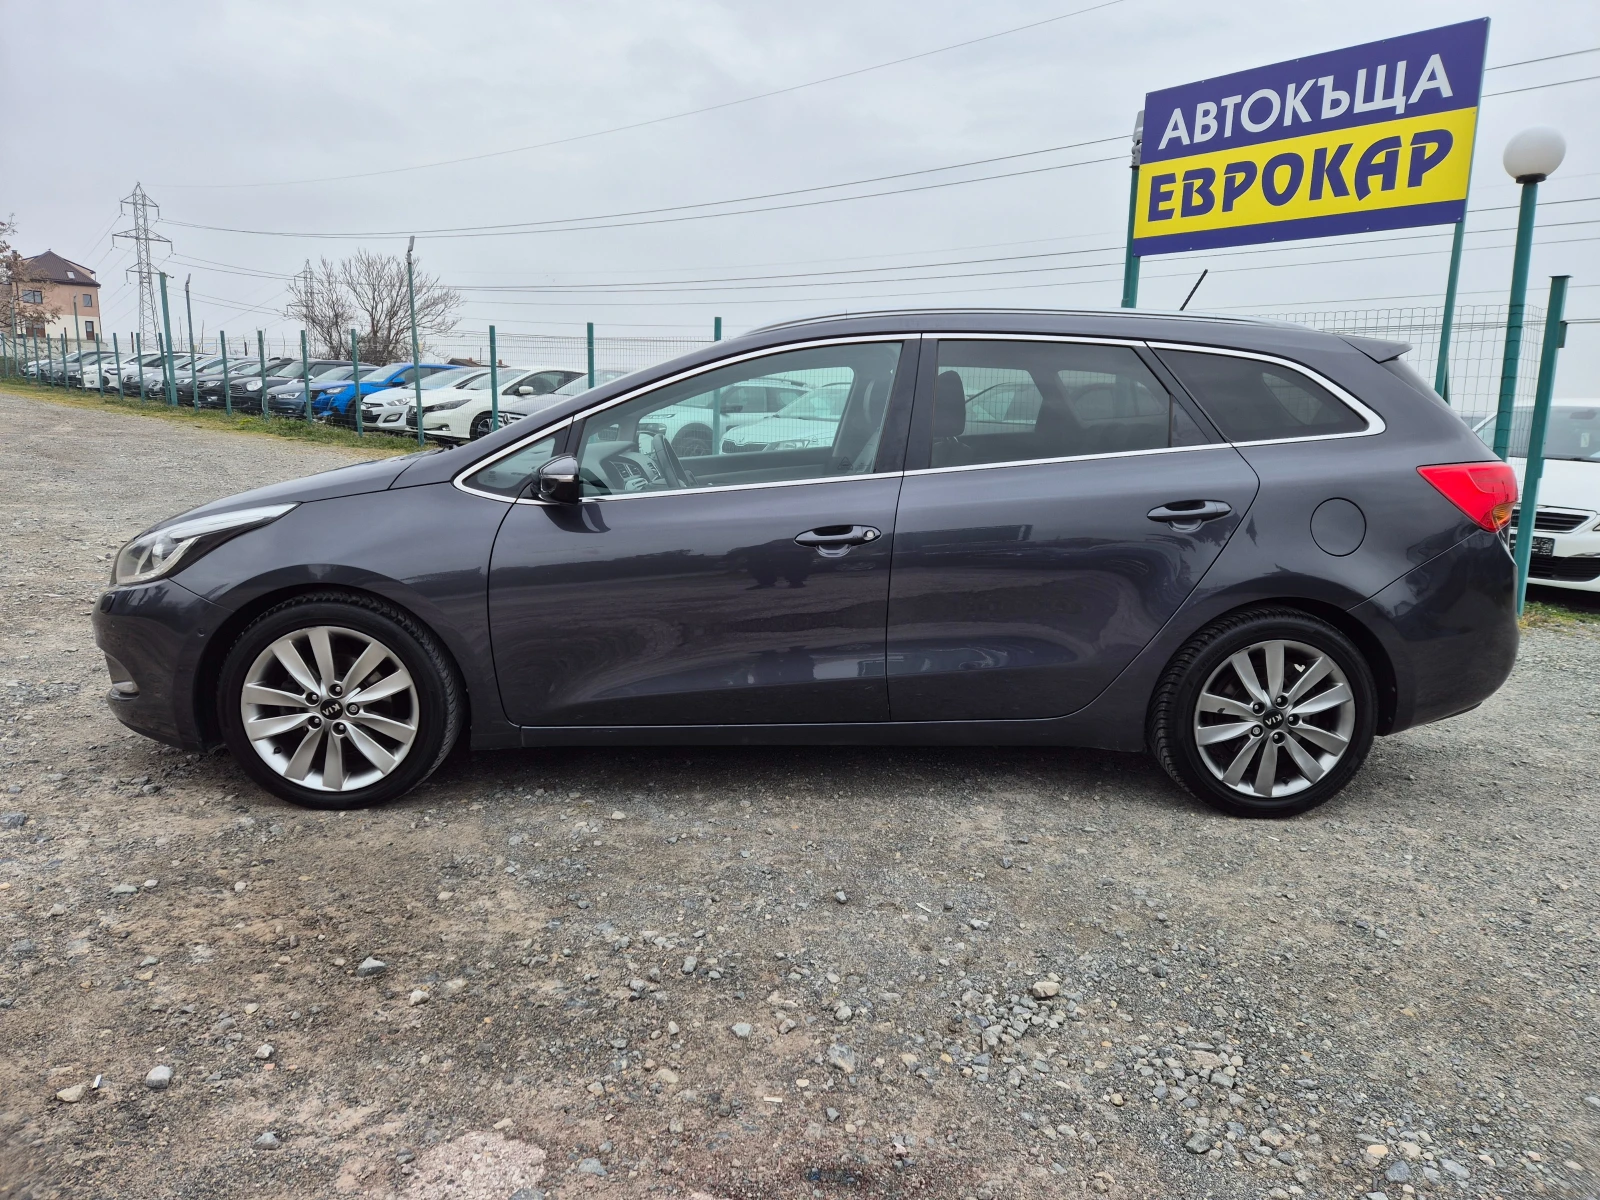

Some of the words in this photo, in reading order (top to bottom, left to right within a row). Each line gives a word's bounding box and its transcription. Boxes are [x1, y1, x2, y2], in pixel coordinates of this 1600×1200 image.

[1157, 53, 1454, 151] АВТОКЪЩА
[1147, 128, 1454, 222] ЕВРОКАР
[322, 703, 340, 716] KIA
[1265, 713, 1282, 726] KIA
